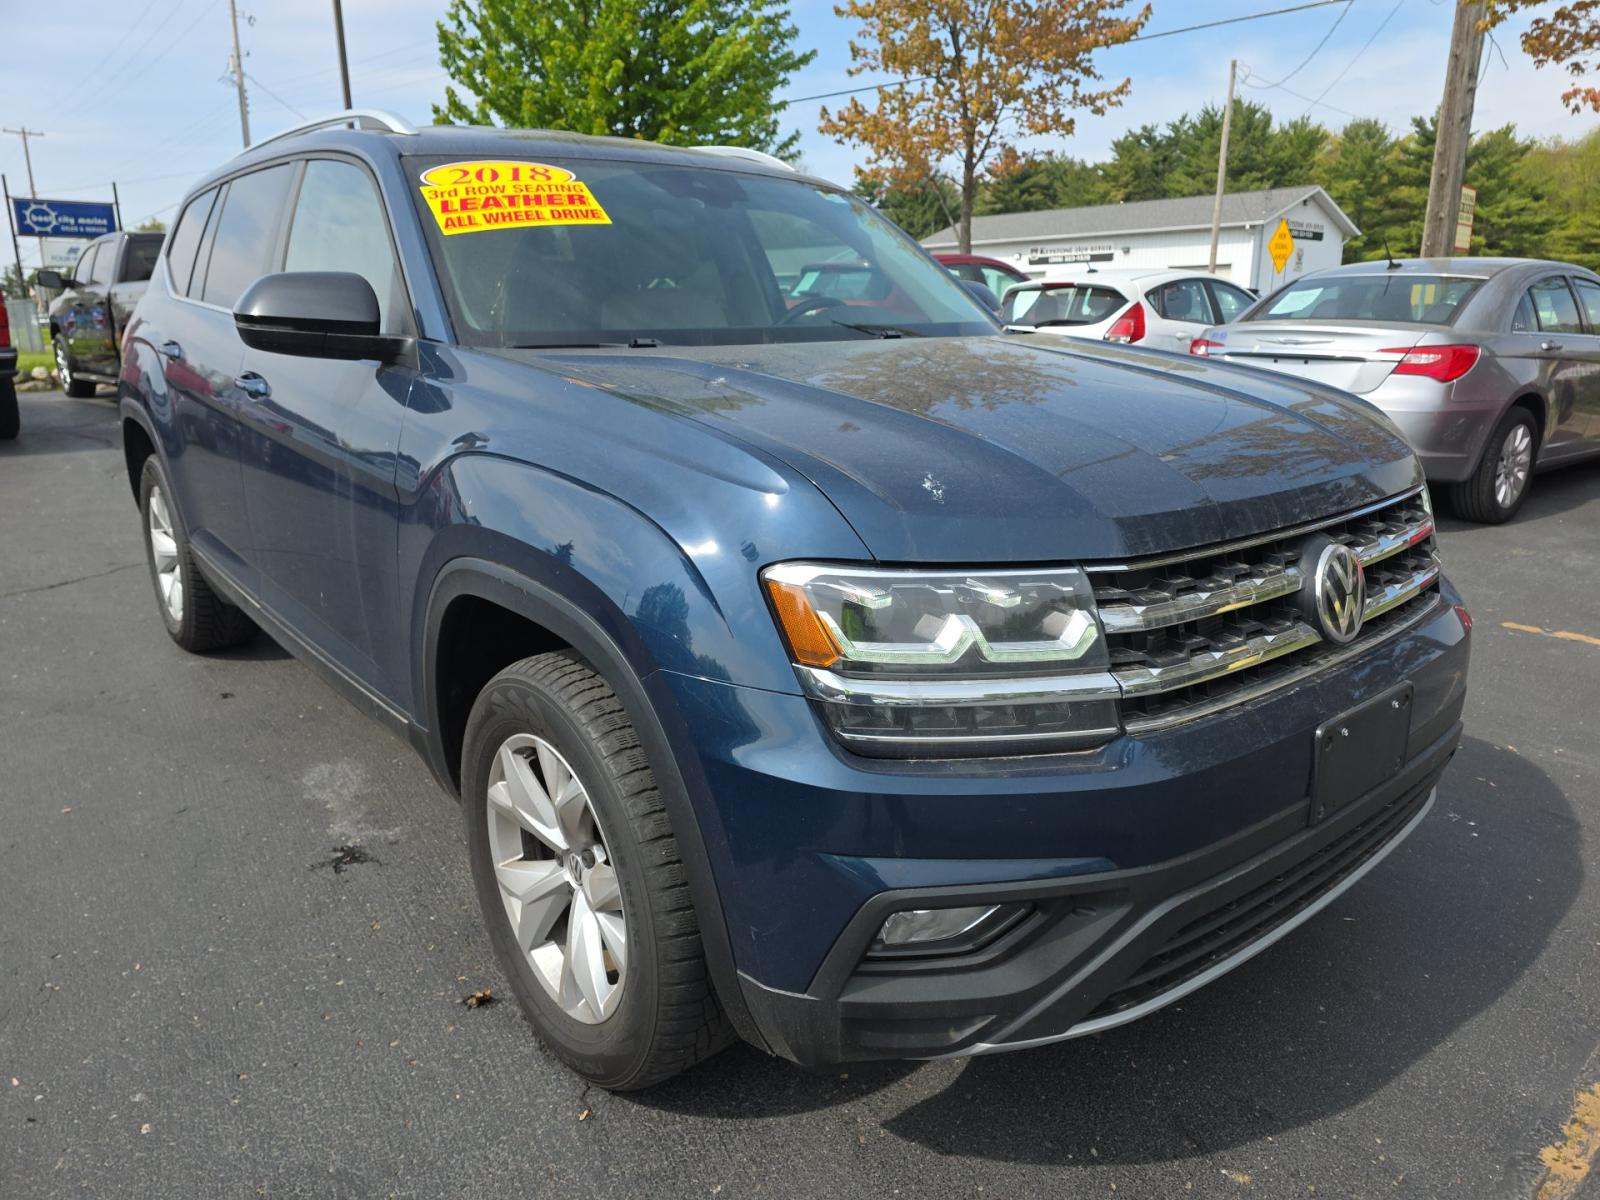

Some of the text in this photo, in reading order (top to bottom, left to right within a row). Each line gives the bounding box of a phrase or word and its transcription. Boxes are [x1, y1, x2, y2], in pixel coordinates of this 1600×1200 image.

[448, 166, 552, 185] 2018
[428, 183, 584, 200] 3rd ROW SEATING
[440, 193, 588, 214] LEATHER
[444, 208, 602, 230] ALL WHEEL DRIVE
